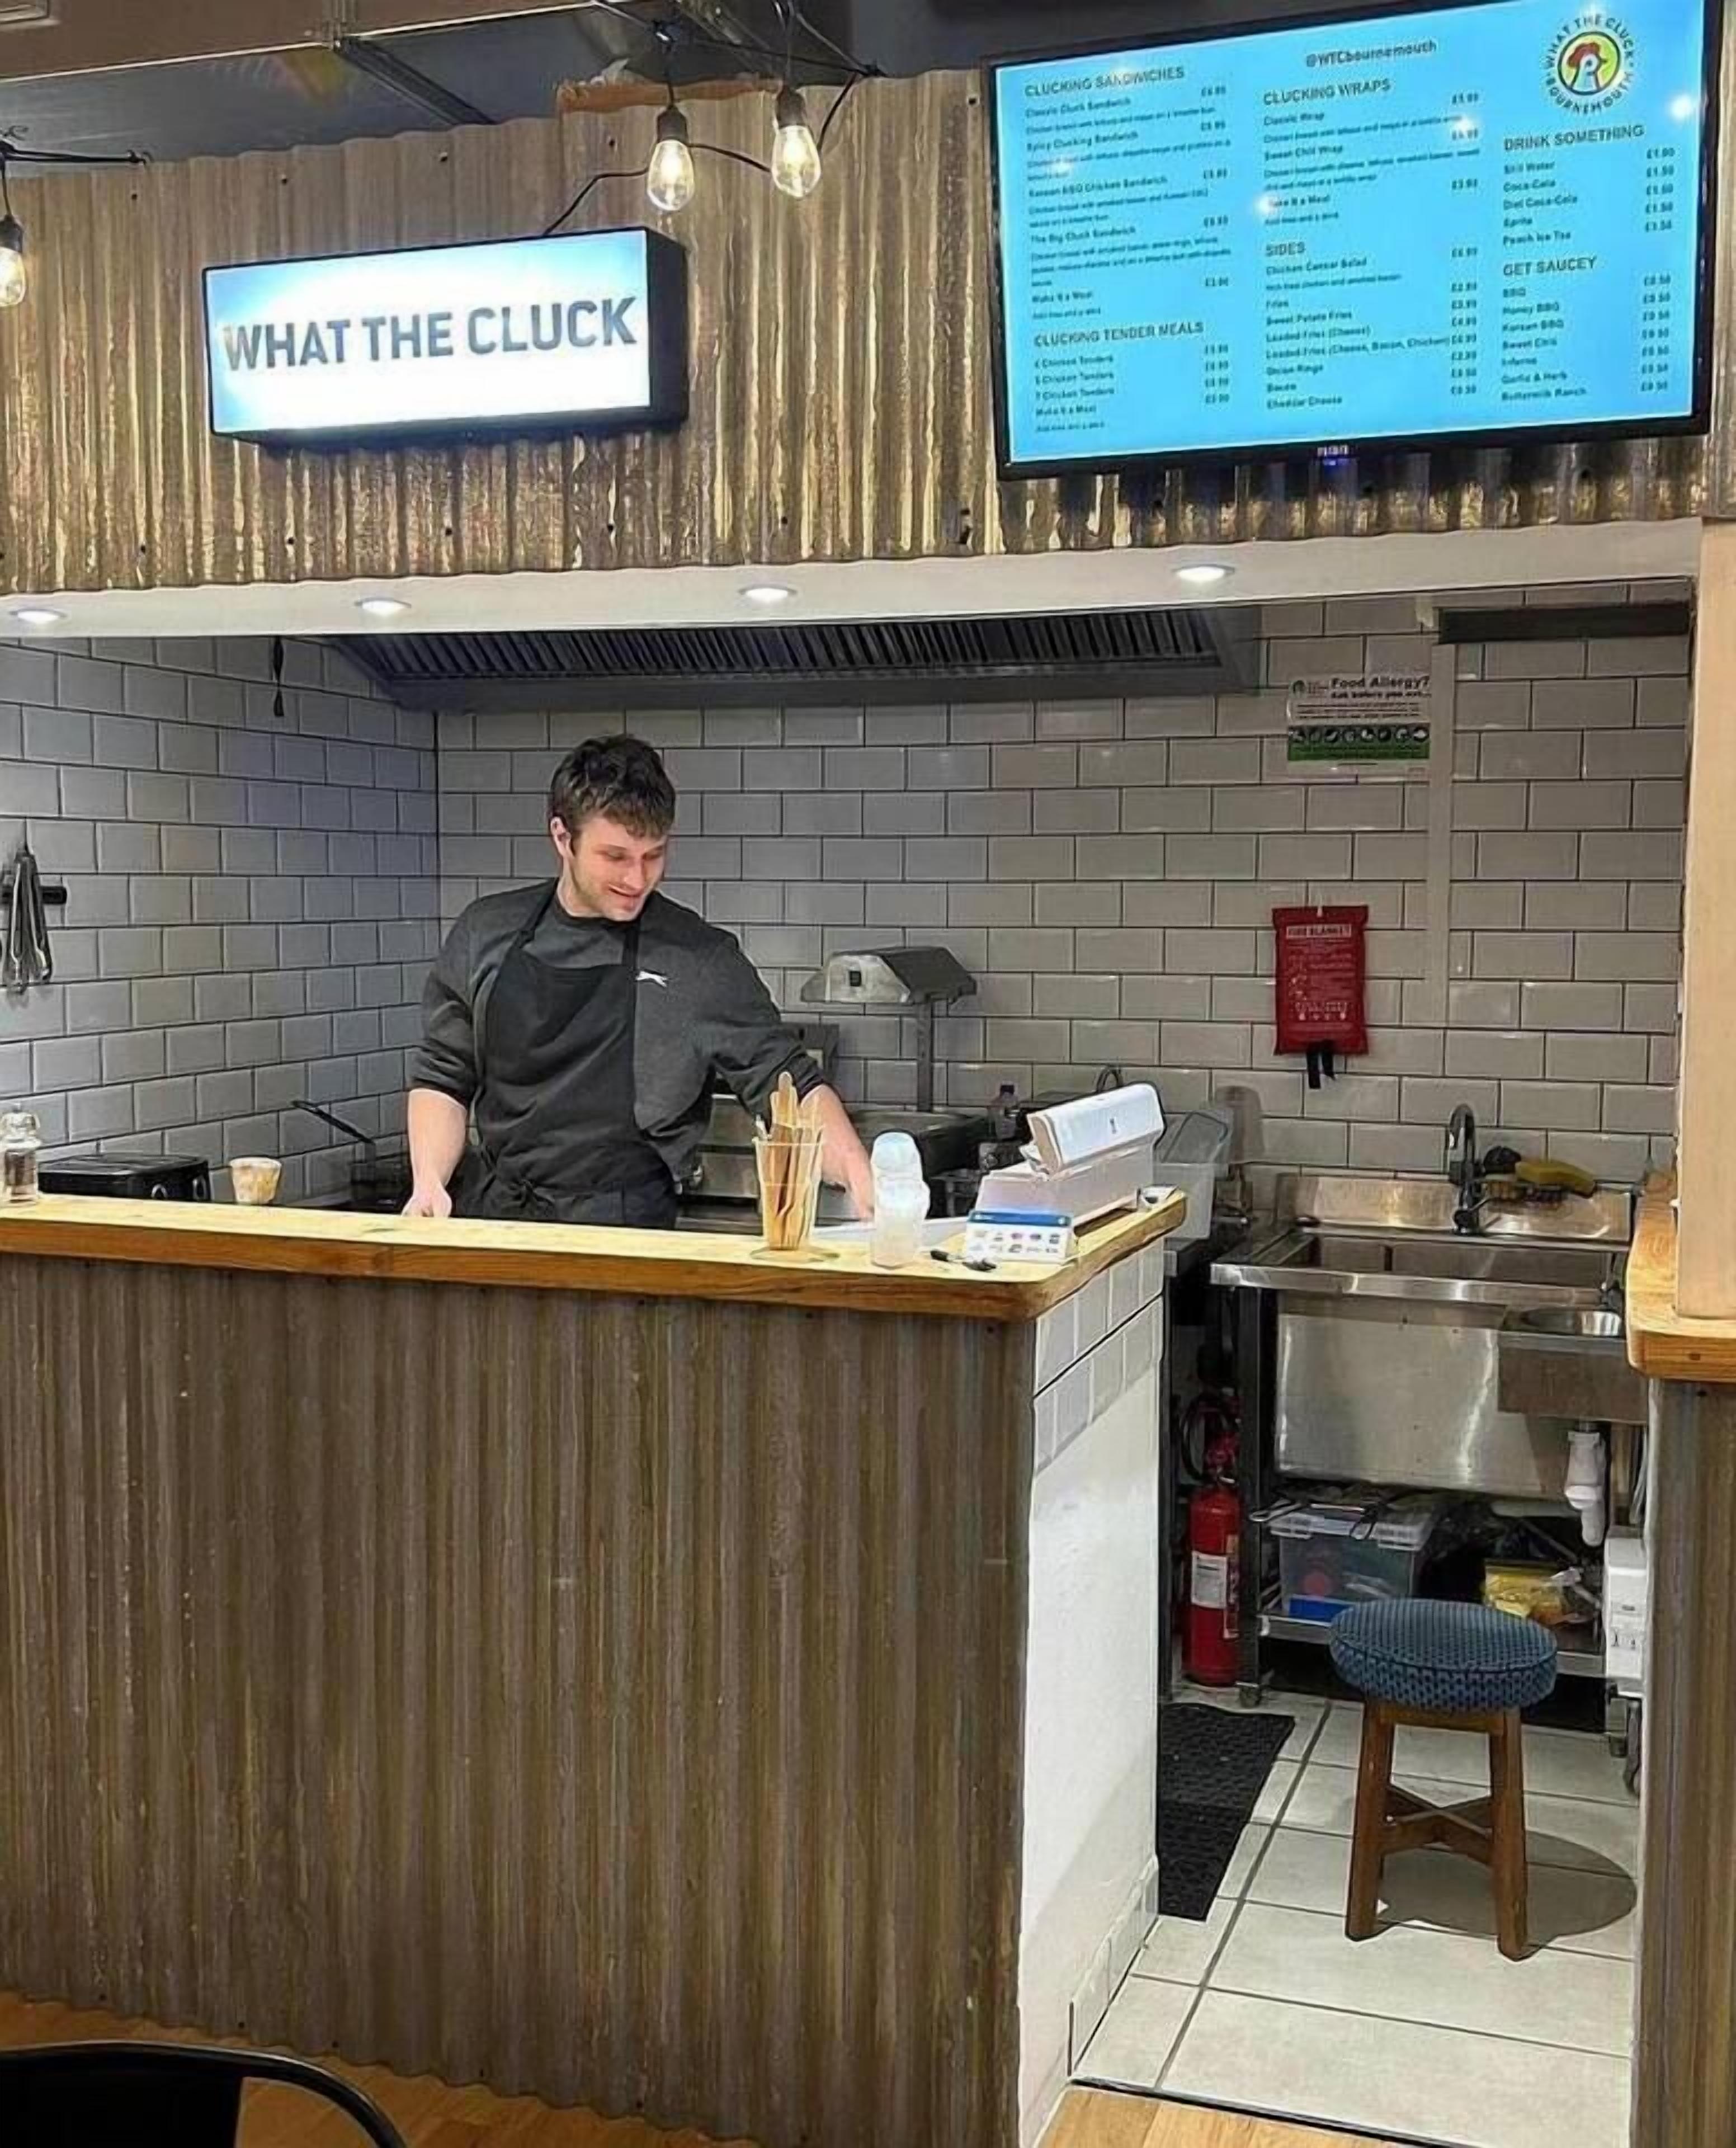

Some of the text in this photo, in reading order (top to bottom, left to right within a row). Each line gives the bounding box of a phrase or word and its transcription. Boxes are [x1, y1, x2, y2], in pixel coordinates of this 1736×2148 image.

[1544, 14, 1634, 69] WHAT THE CLUCK
[1025, 65, 1185, 96] CLUCKING SANDWICHES
[1264, 78, 1390, 105] CLUCKING WRAPS
[1504, 124, 1645, 151] DRINK SOMETHING
[1265, 242, 1305, 257] SIDES
[1503, 255, 1597, 276] GET SAUCEY
[223, 295, 638, 371] WHAT THE CLUCK
[1035, 321, 1204, 347] CLUCKING TENDER MEALS
[1331, 675, 1430, 690] Food Allergy?
